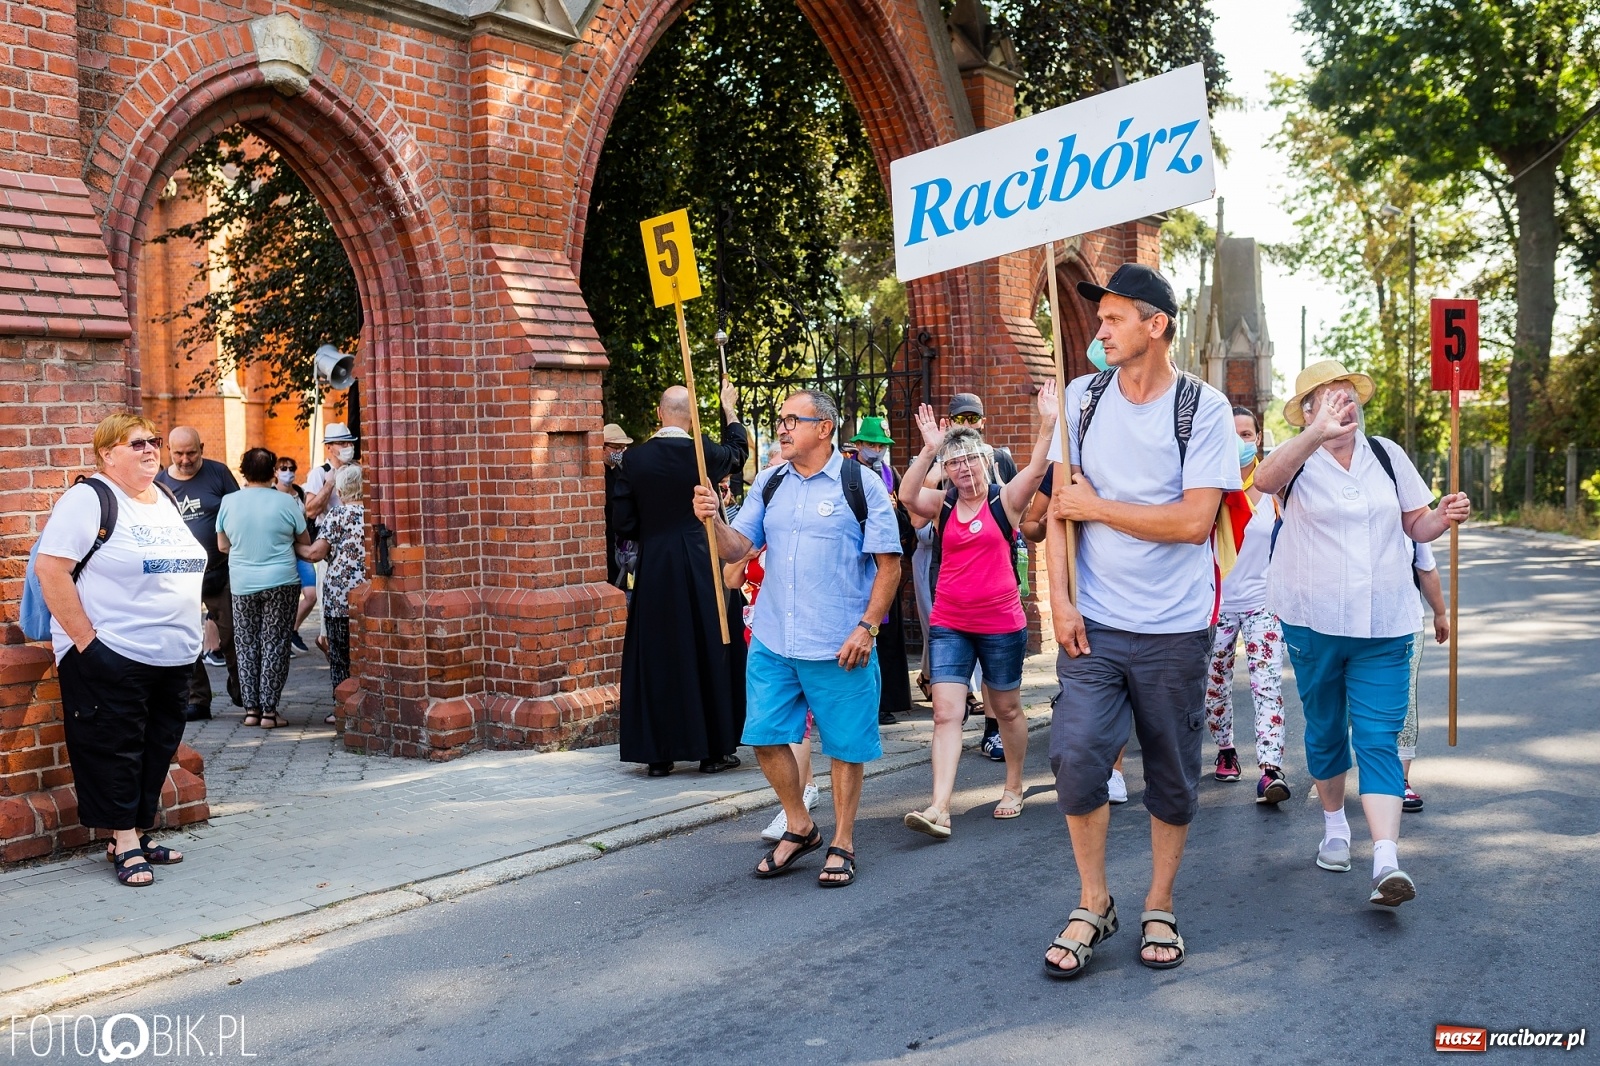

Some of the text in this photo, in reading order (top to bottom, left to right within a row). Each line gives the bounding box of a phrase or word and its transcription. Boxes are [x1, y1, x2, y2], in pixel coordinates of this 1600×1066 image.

[904, 117, 1203, 247] Racibórz
[653, 221, 680, 277] 5
[1444, 308, 1467, 363] 5
